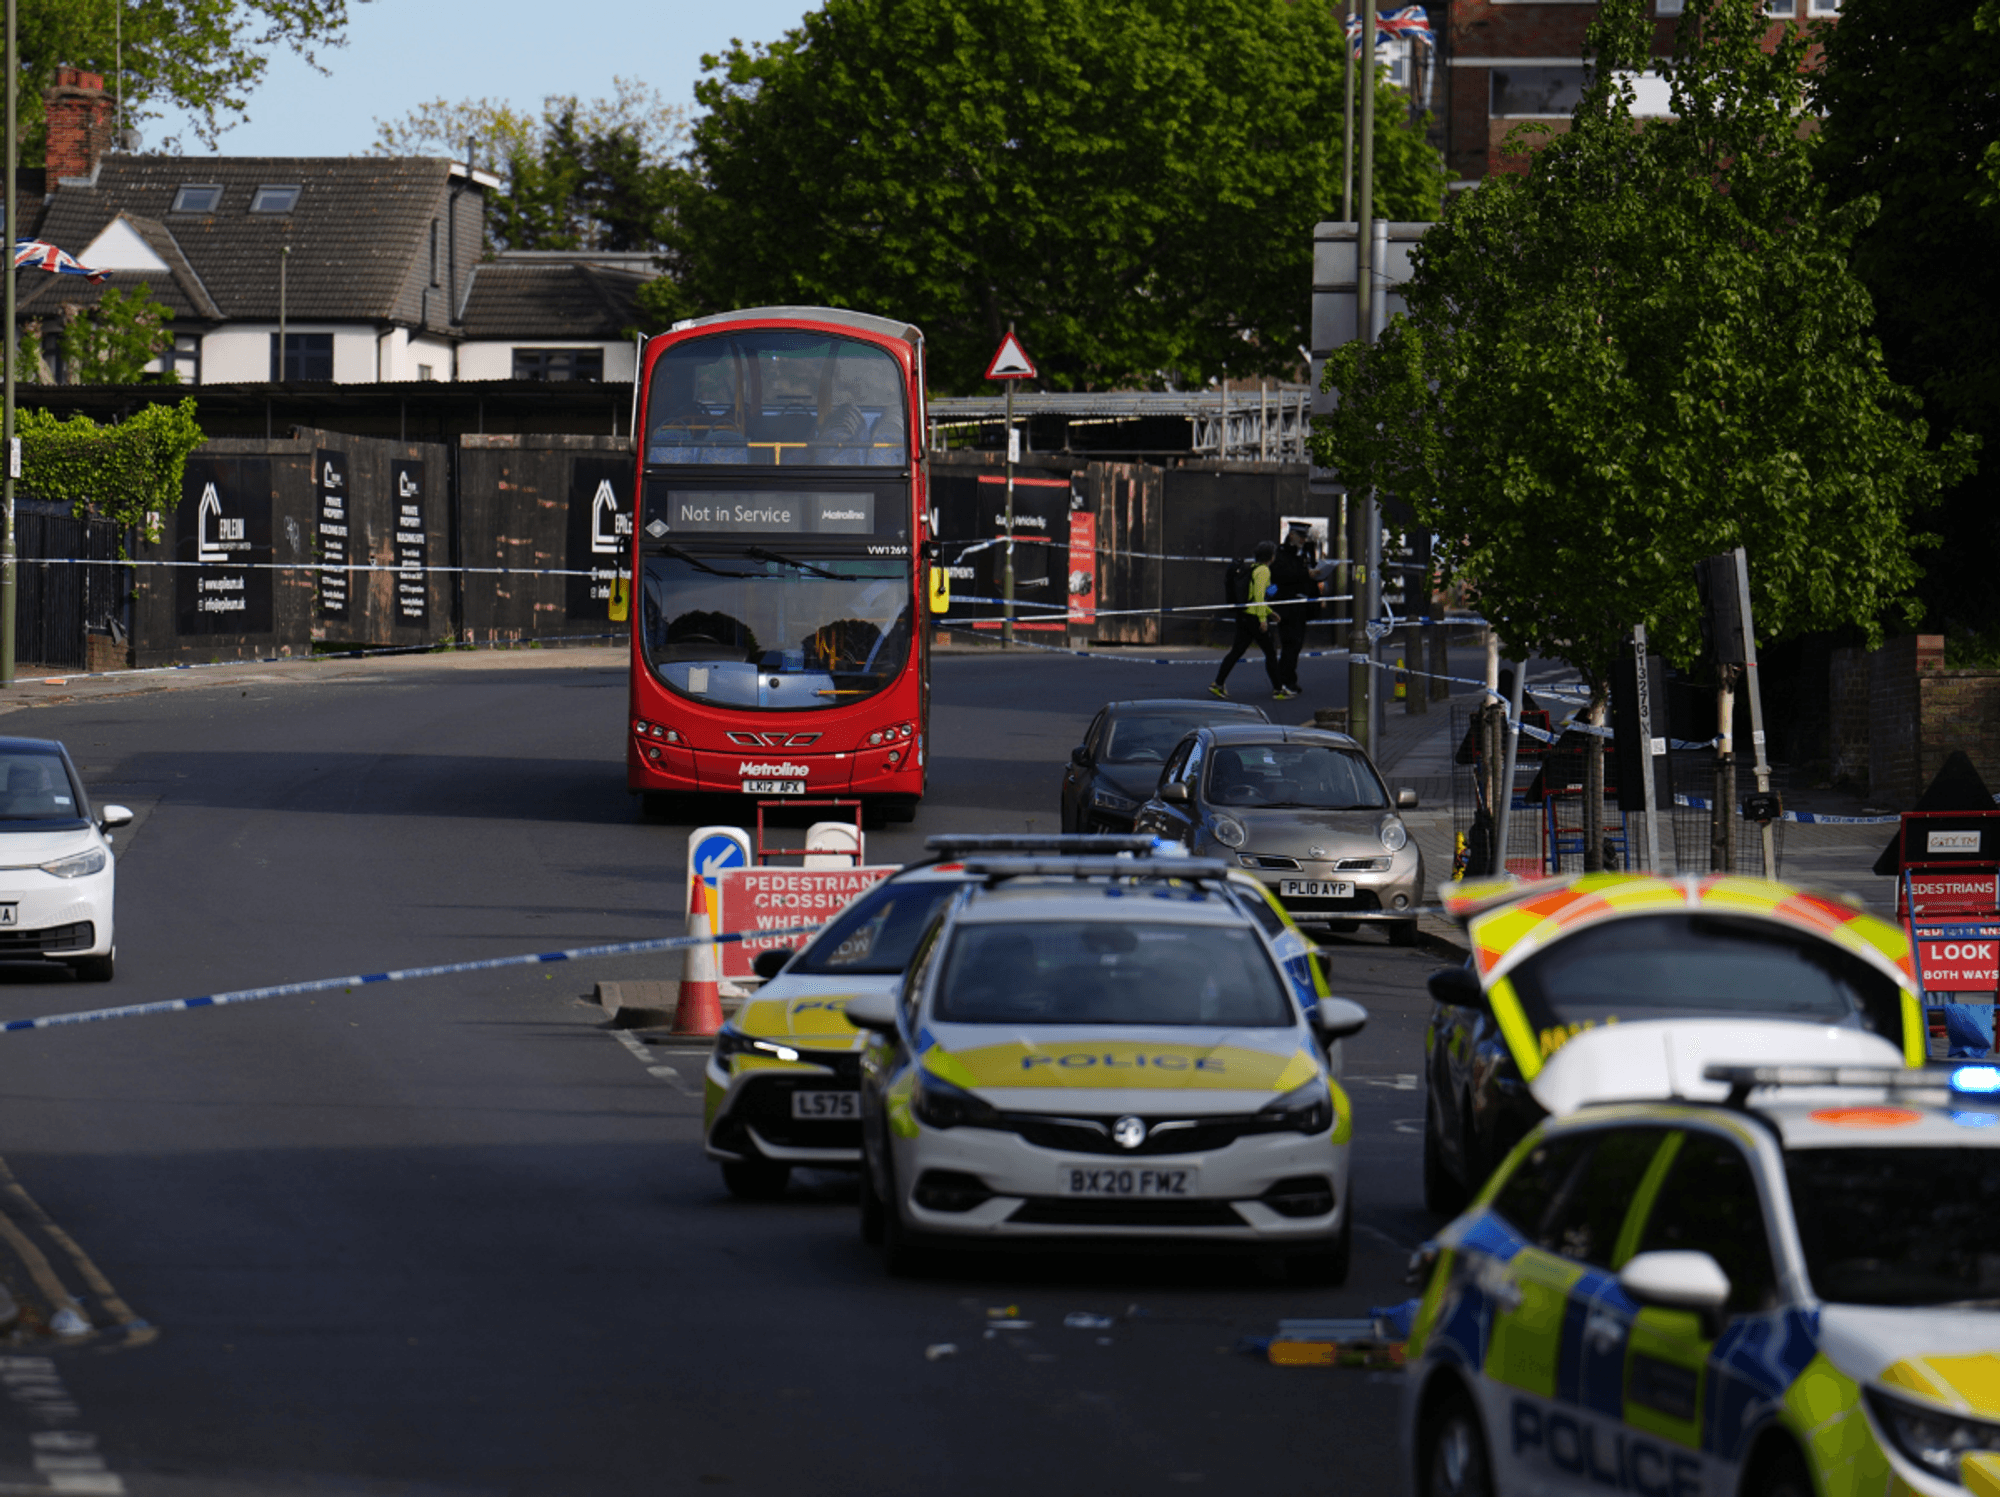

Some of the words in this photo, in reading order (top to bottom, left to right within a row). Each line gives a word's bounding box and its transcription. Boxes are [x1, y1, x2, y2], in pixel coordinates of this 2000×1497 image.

[681, 505, 710, 521] Not
[716, 505, 730, 522] in
[735, 505, 791, 523] Service
[822, 509, 865, 520] Metroline
[867, 546, 907, 555] VW1269
[738, 762, 809, 776] Metroline
[748, 781, 774, 793] LK12
[780, 782, 800, 793] AFX
[745, 876, 877, 891] PEDESTRIAN
[1288, 882, 1318, 895] PL10
[1322, 883, 1347, 896] AYP
[755, 893, 860, 909] CROSSIN
[756, 915, 817, 930] WHEN
[1931, 944, 1992, 960] LOOK
[1924, 970, 1958, 980] BOTH
[1962, 970, 1999, 980] WAYS
[1021, 1053, 1227, 1075] POLICE
[1070, 1169, 1133, 1194] BX20
[1140, 1170, 1187, 1194] FMZ
[1510, 1394, 1702, 1497] POLICE
